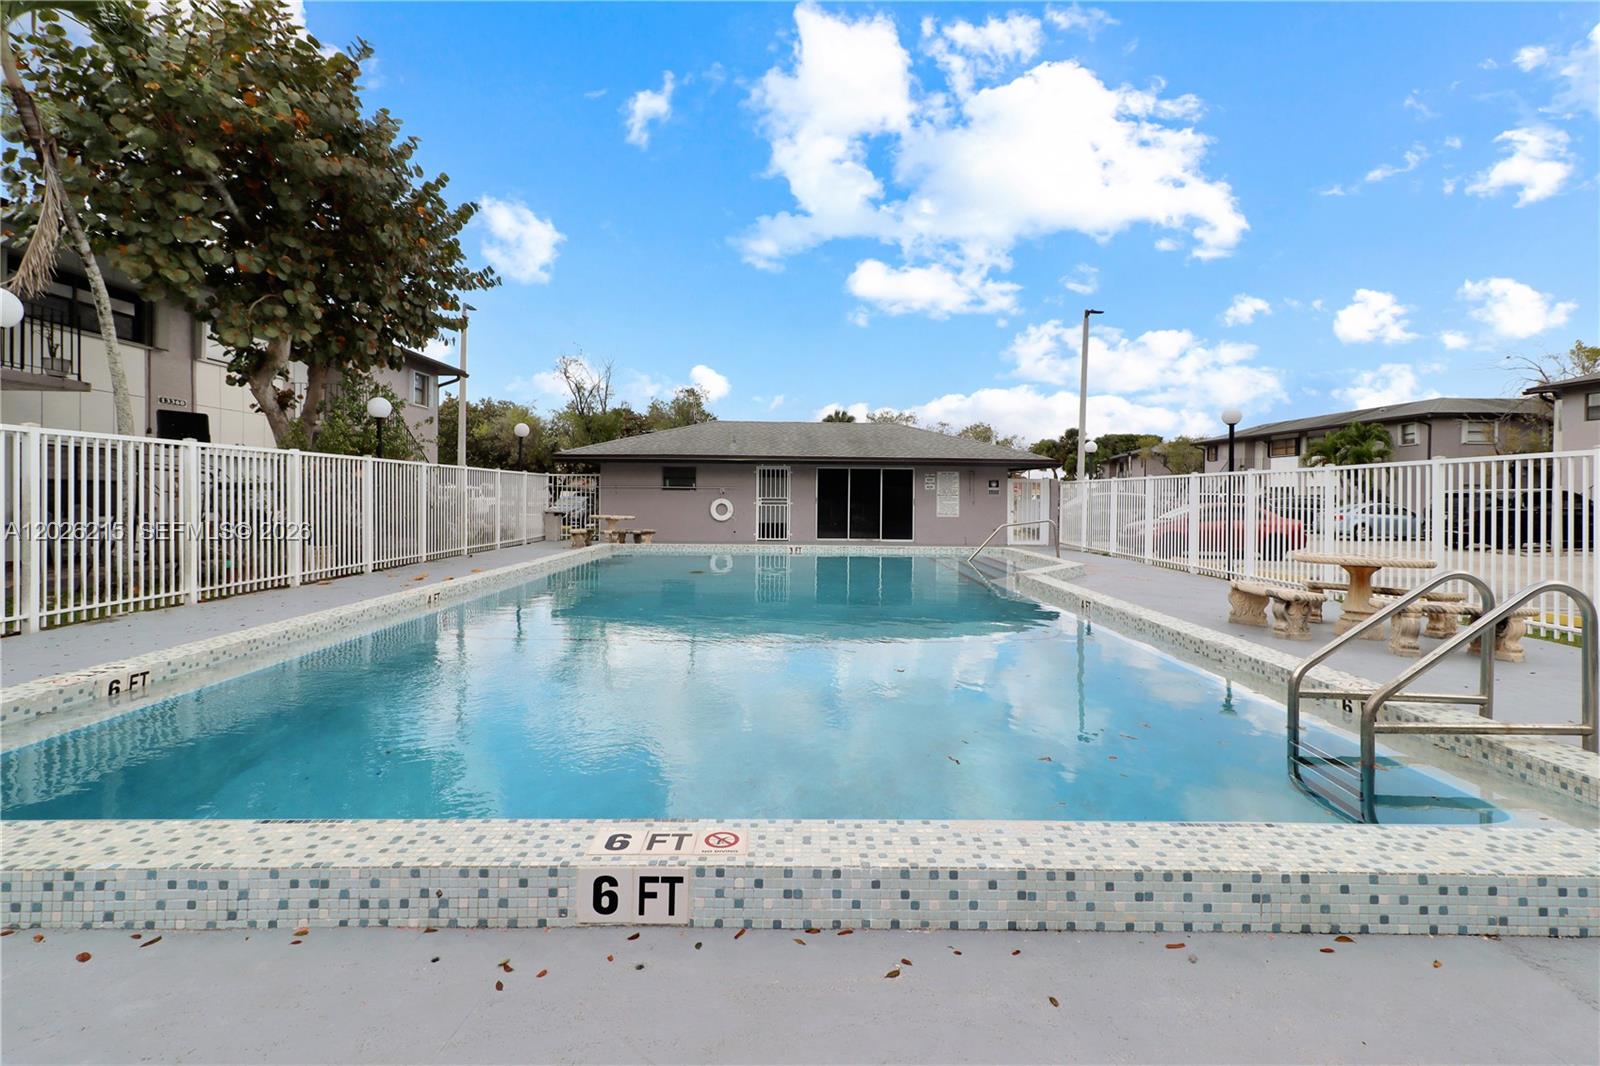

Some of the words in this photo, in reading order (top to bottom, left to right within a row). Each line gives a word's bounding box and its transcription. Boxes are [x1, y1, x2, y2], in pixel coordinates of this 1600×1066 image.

[108, 679, 121, 697] 6
[129, 671, 150, 690] FT
[1342, 698, 1353, 713] 6
[604, 833, 633, 851] 6
[646, 833, 693, 851] FT
[593, 875, 619, 915] 6
[638, 876, 684, 916] FT
